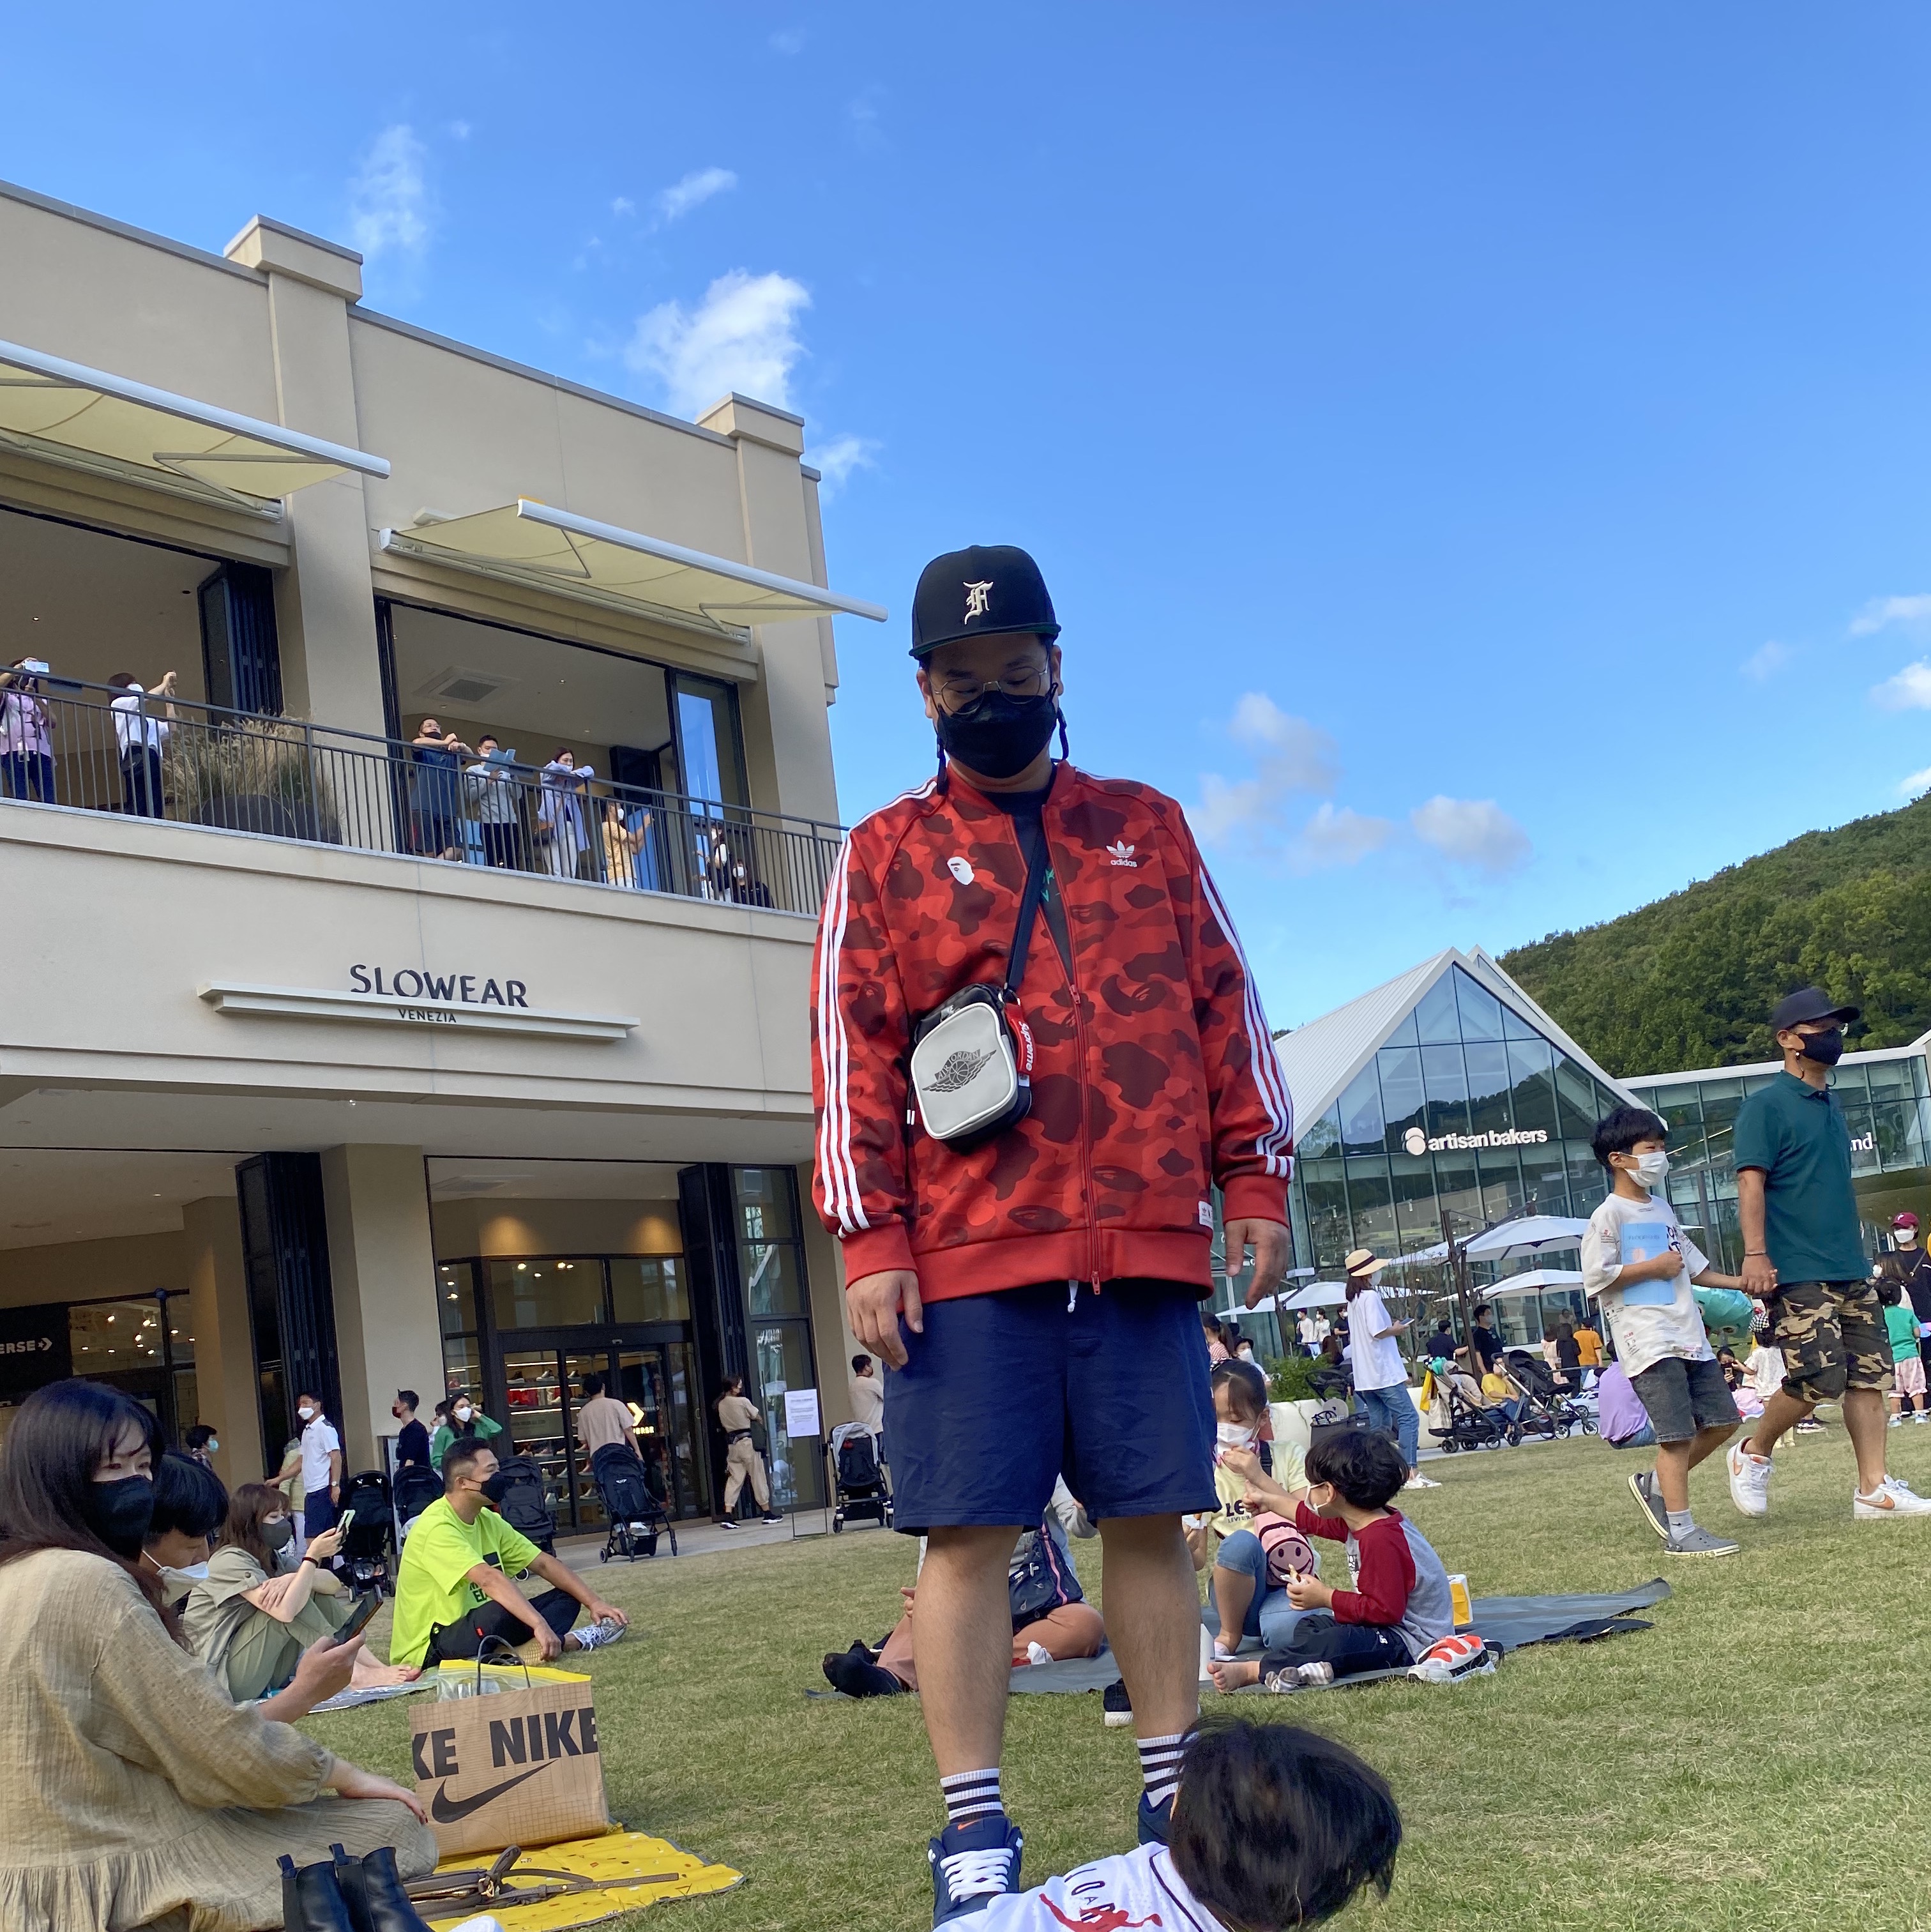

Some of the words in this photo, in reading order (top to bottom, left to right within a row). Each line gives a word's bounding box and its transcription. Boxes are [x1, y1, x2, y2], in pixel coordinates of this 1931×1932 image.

[1110, 859, 1137, 867] adidas
[350, 964, 529, 1007] SLOWEAR
[398, 1008, 457, 1023] VENEZIA
[1019, 1021, 1034, 1071] Supreme
[938, 1065, 950, 1079] AIR
[948, 1051, 980, 1063] JORDAN
[1428, 1133, 1488, 1151] artisan
[1488, 1129, 1548, 1146] bakers
[1851, 1132, 1873, 1152] nd
[489, 1707, 598, 1768] NIKE
